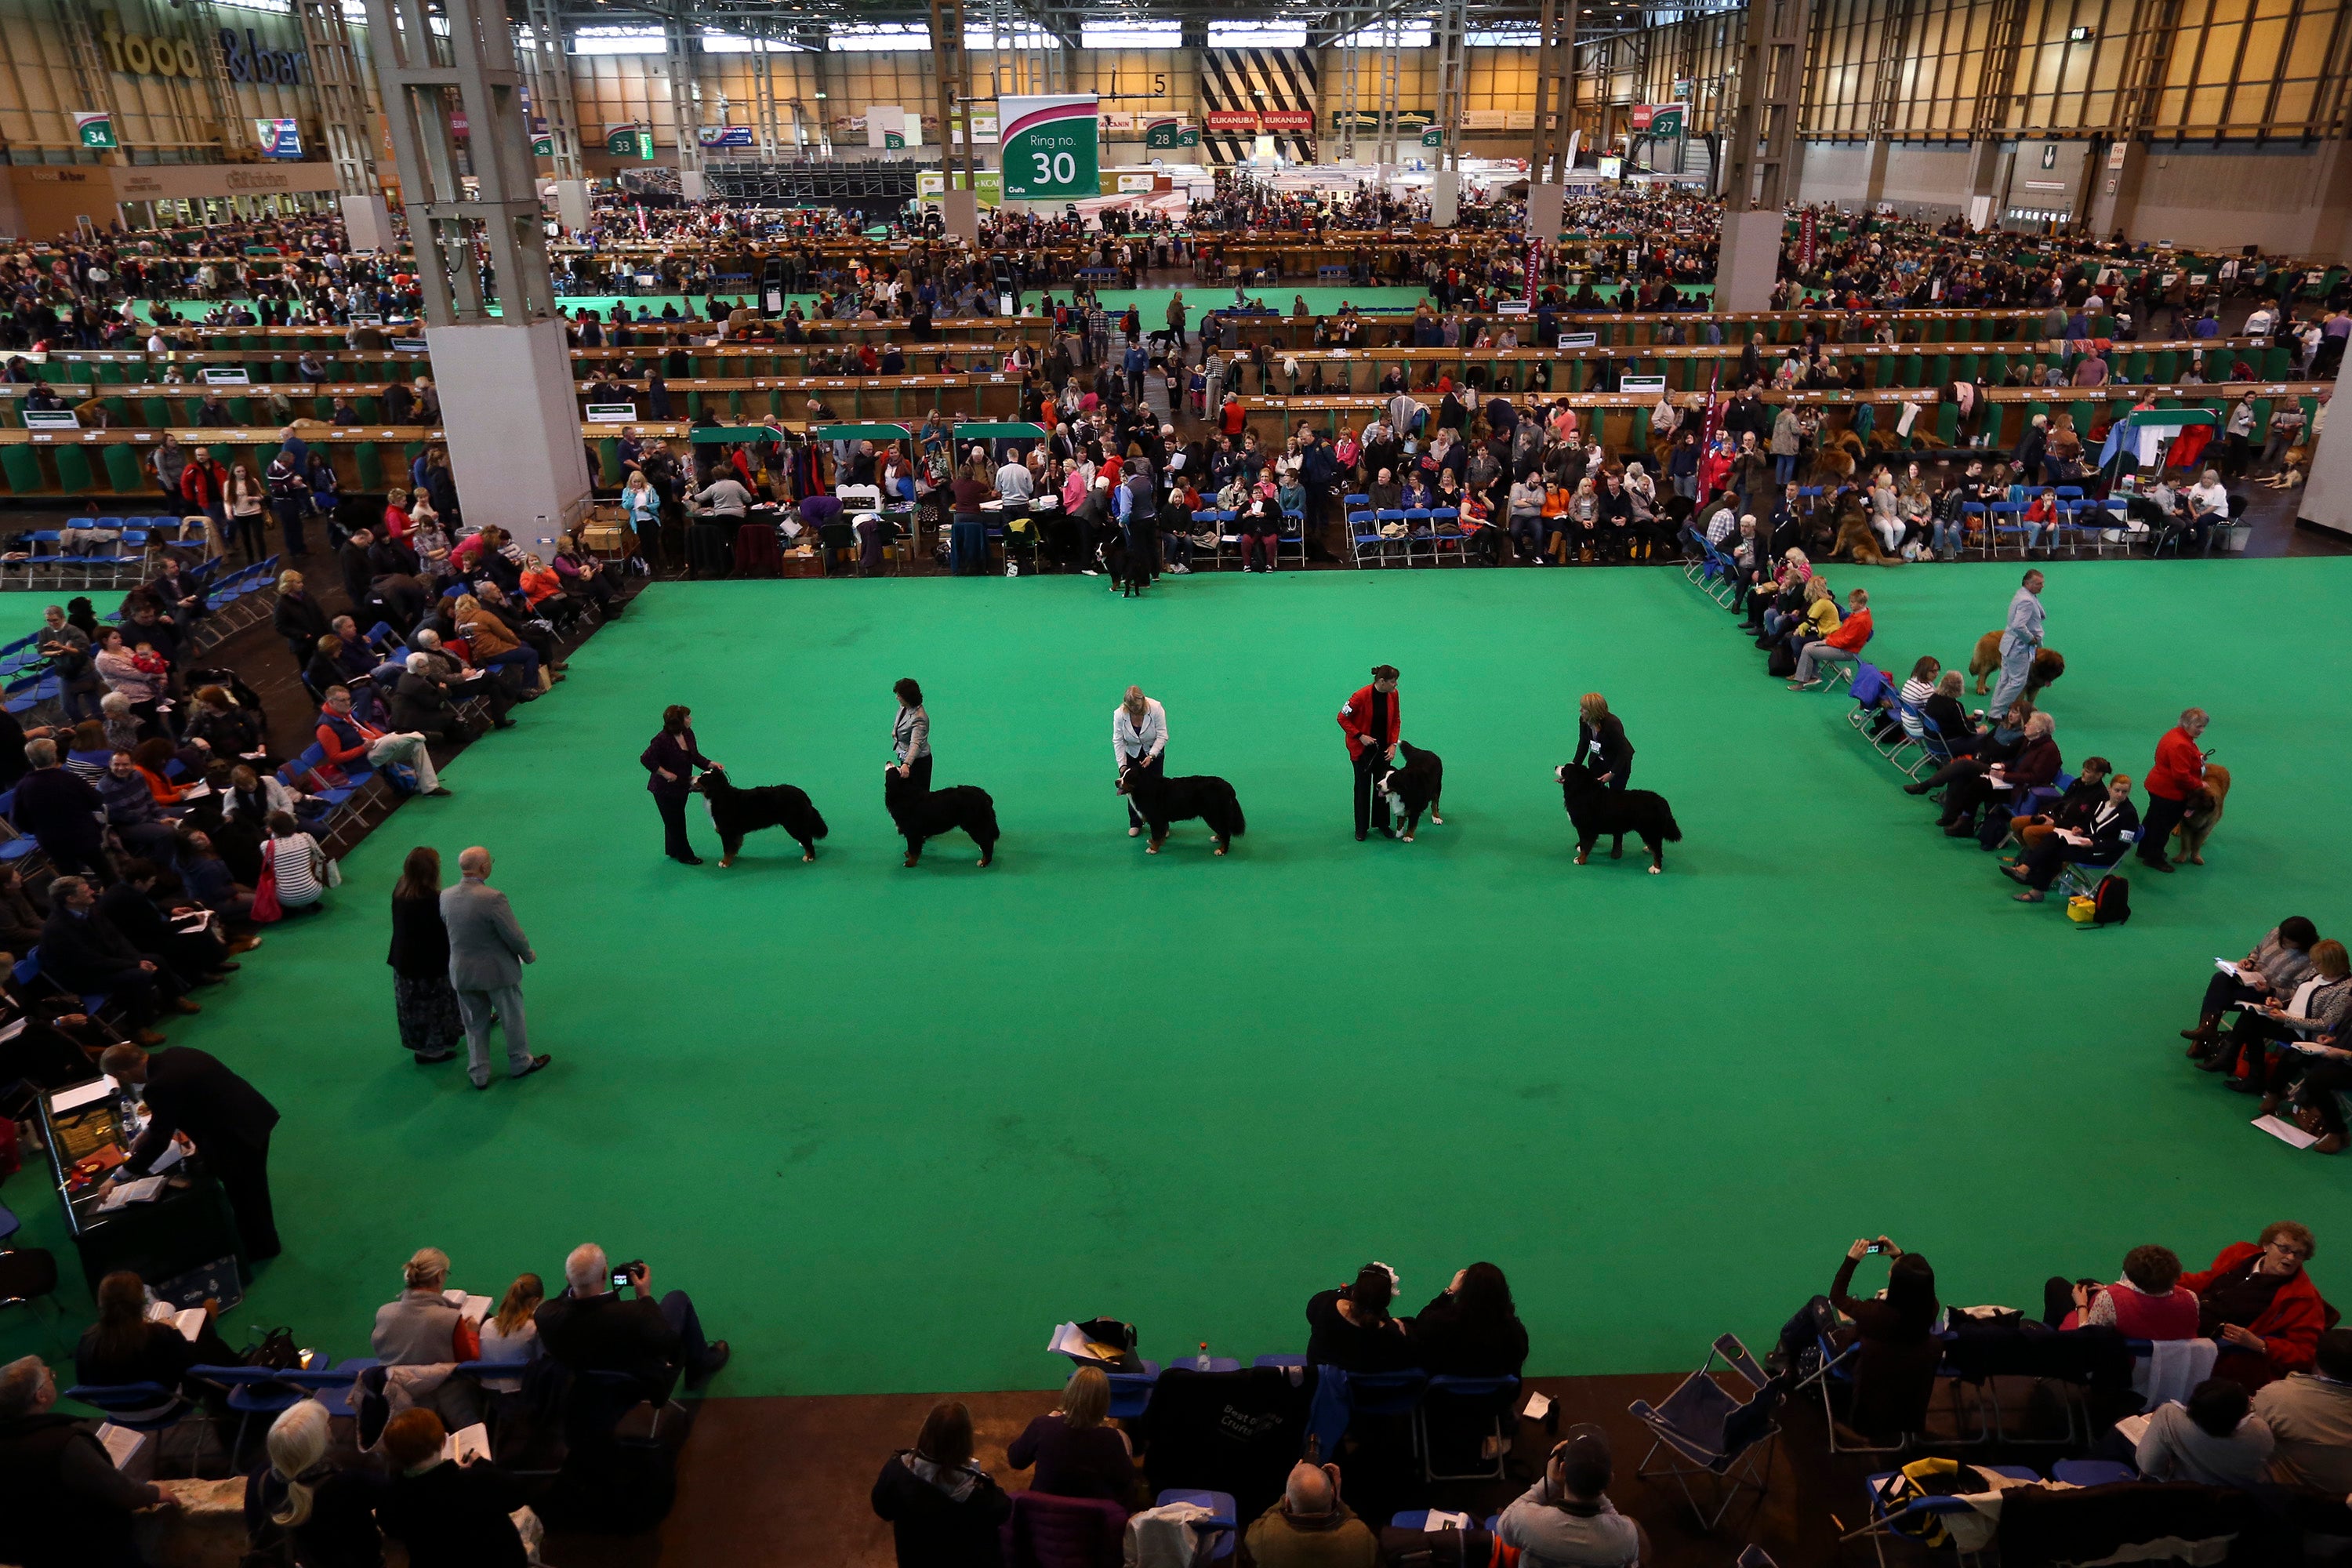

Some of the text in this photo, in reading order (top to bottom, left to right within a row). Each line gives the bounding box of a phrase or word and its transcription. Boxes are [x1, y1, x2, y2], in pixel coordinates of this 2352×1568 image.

[103, 14, 302, 85] food & bar
[1154, 74, 1165, 93] 5
[1659, 122, 1674, 132] 27
[89, 131, 106, 143] 34
[1030, 135, 1076, 149] Ring no.
[1156, 134, 1170, 145] 28
[616, 141, 630, 151] 33
[1032, 152, 1076, 184] 30
[1224, 1404, 1249, 1423] Best
[1221, 1416, 1254, 1436] Crufts
